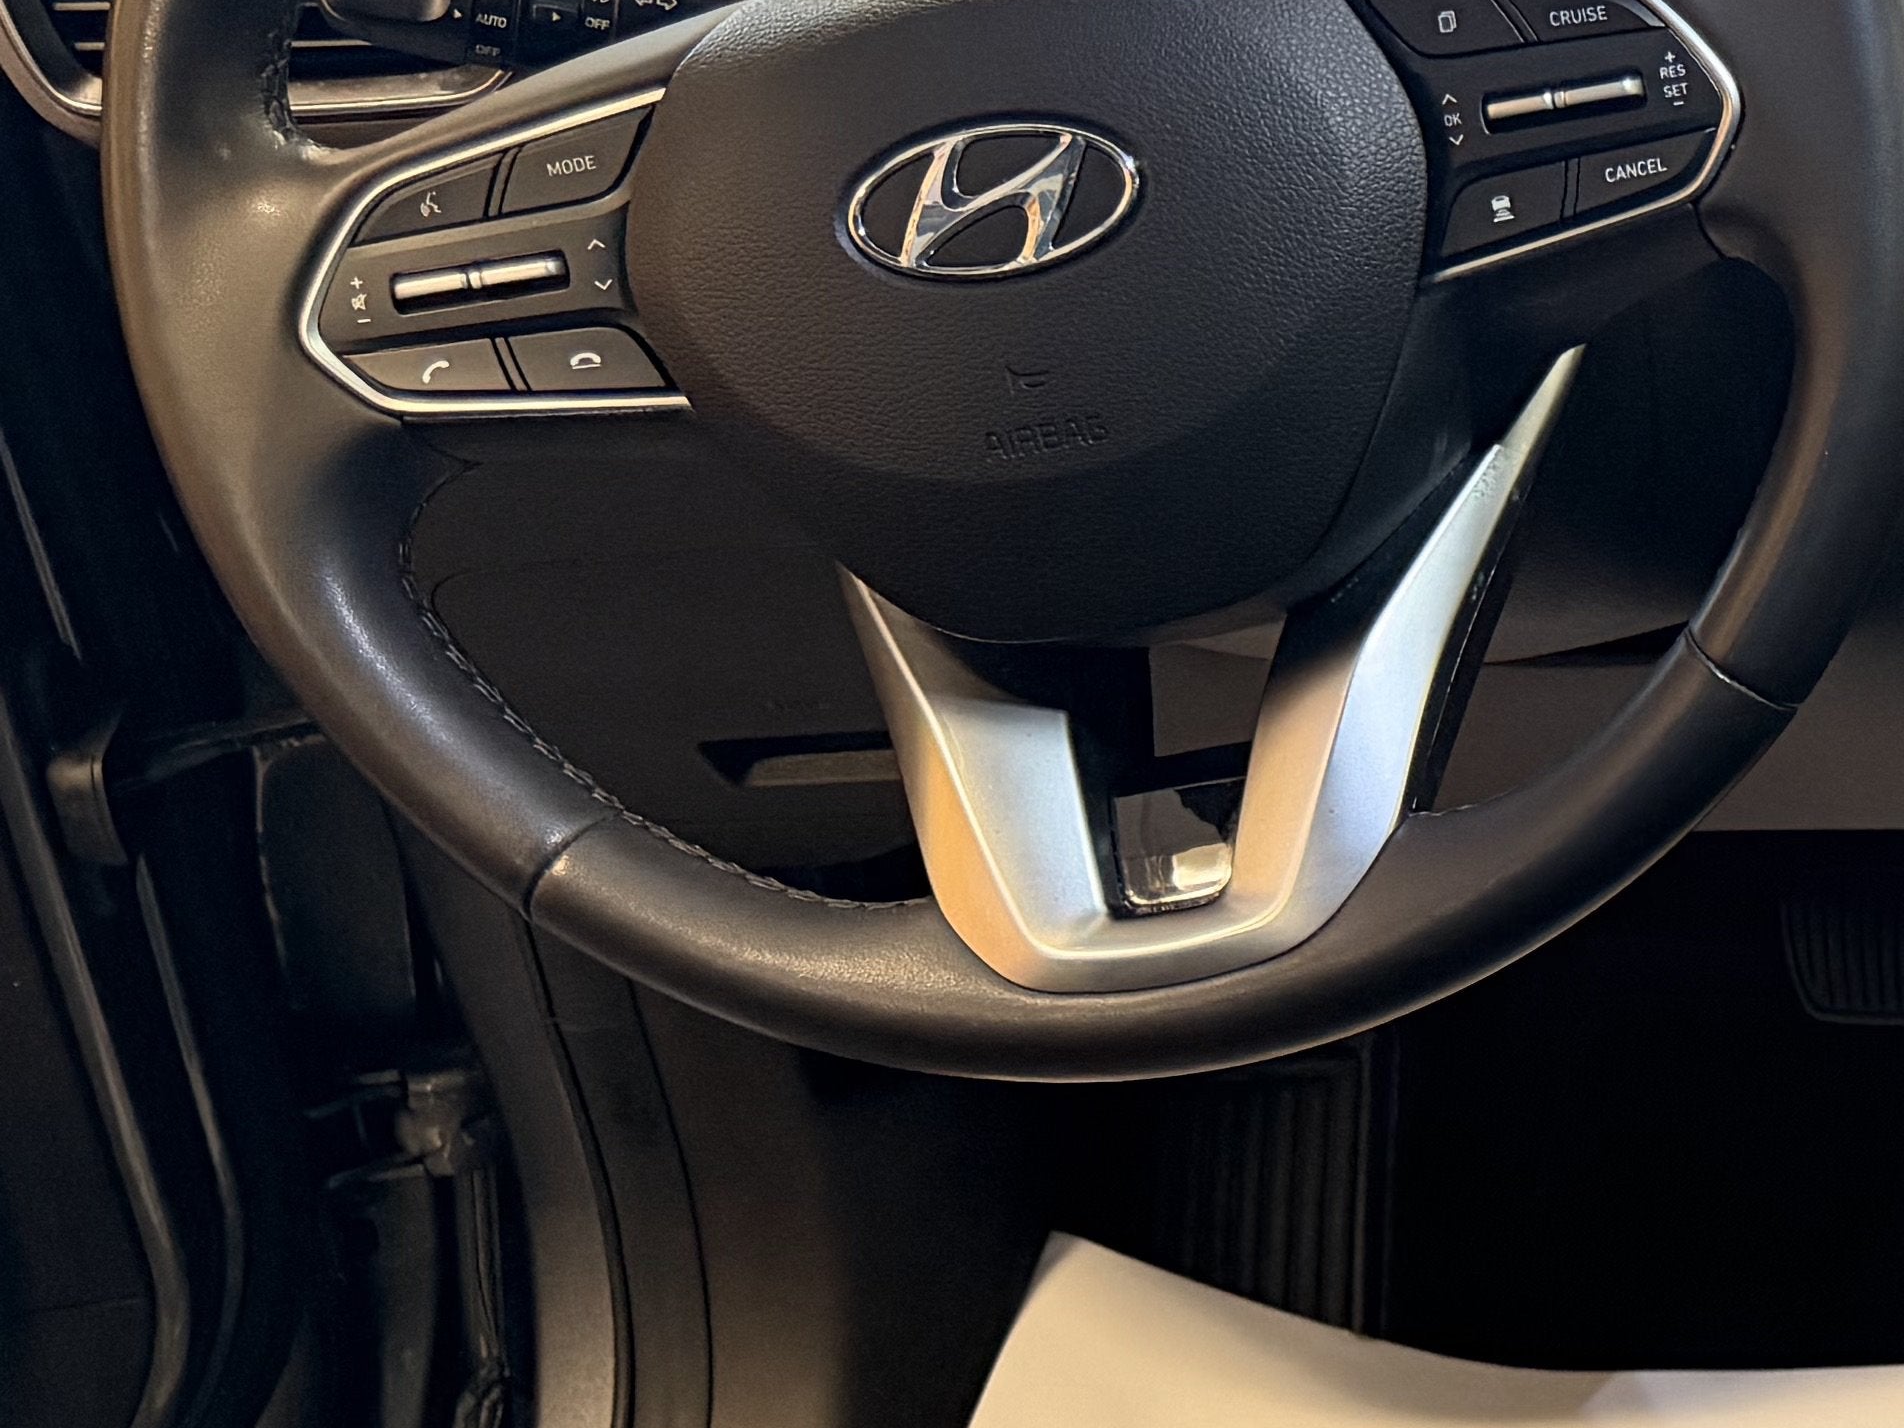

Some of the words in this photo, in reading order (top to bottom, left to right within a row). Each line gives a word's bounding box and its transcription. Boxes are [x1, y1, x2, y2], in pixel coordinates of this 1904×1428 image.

[475, 13, 507, 29] AUTO
[585, 16, 610, 30] OFF
[1549, 4, 1608, 27] CRUISE
[475, 43, 501, 56] OFF
[1659, 64, 1686, 80] RES
[1663, 83, 1688, 98] SET
[1443, 112, 1462, 127] OK
[546, 155, 597, 177] MODE
[1604, 157, 1668, 183] CANCEL
[984, 414, 1109, 461] AIRBAG
